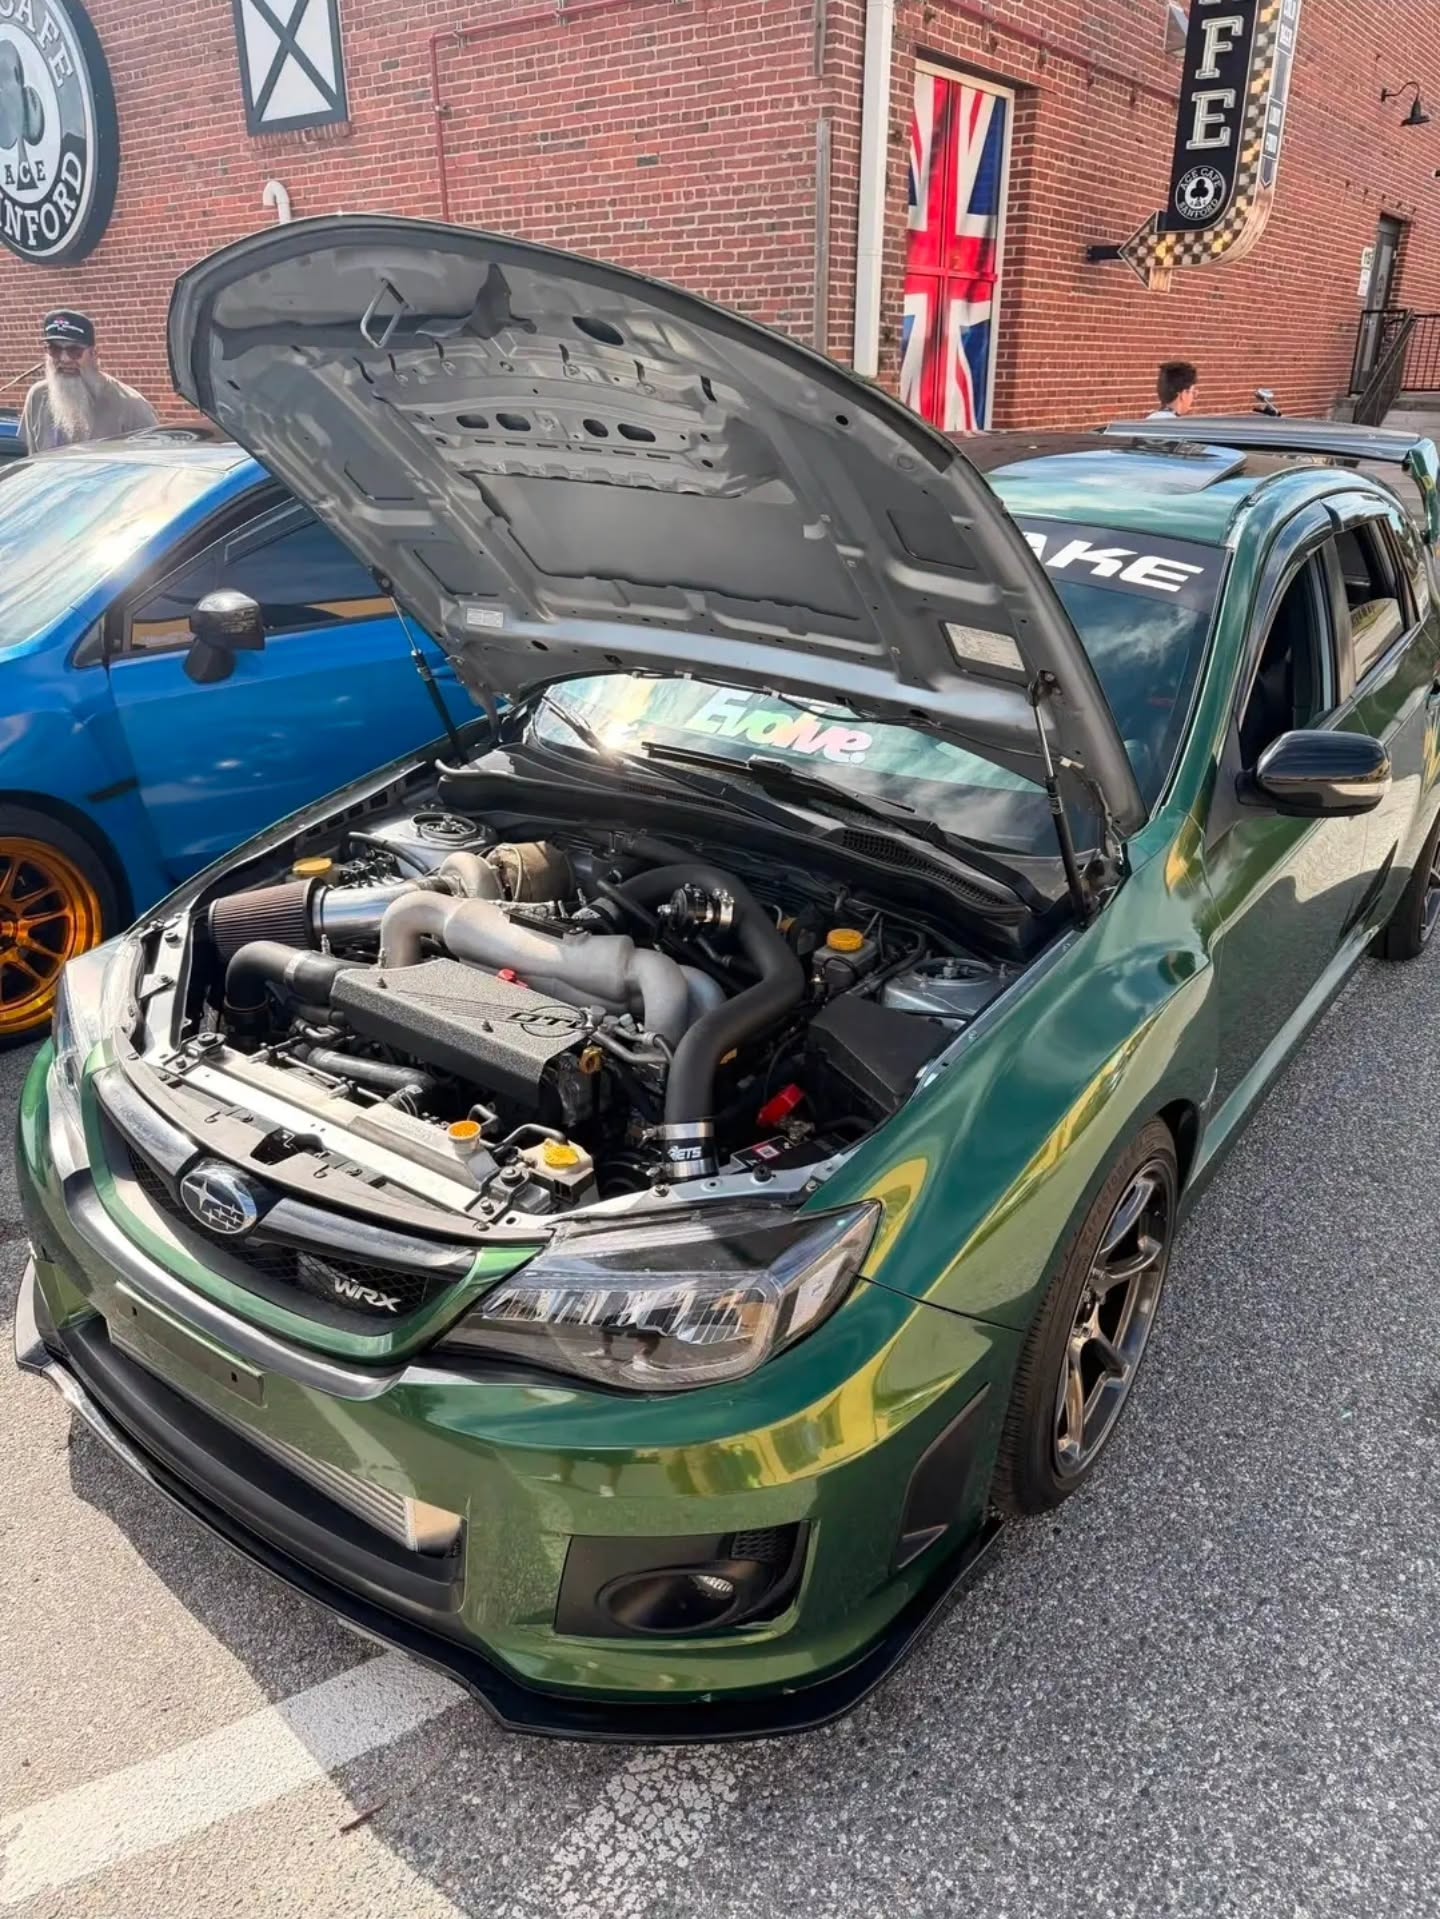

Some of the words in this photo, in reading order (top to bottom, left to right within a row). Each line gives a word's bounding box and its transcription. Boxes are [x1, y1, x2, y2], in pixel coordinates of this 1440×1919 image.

[1186, 0, 1244, 150] FE
[4, 160, 46, 185] ACE
[1180, 170, 1199, 190] ACE
[1200, 167, 1222, 188] CAFE
[0, 152, 82, 246] NFORD
[1178, 198, 1218, 218] SANFORD
[334, 1277, 401, 1312] WRX
